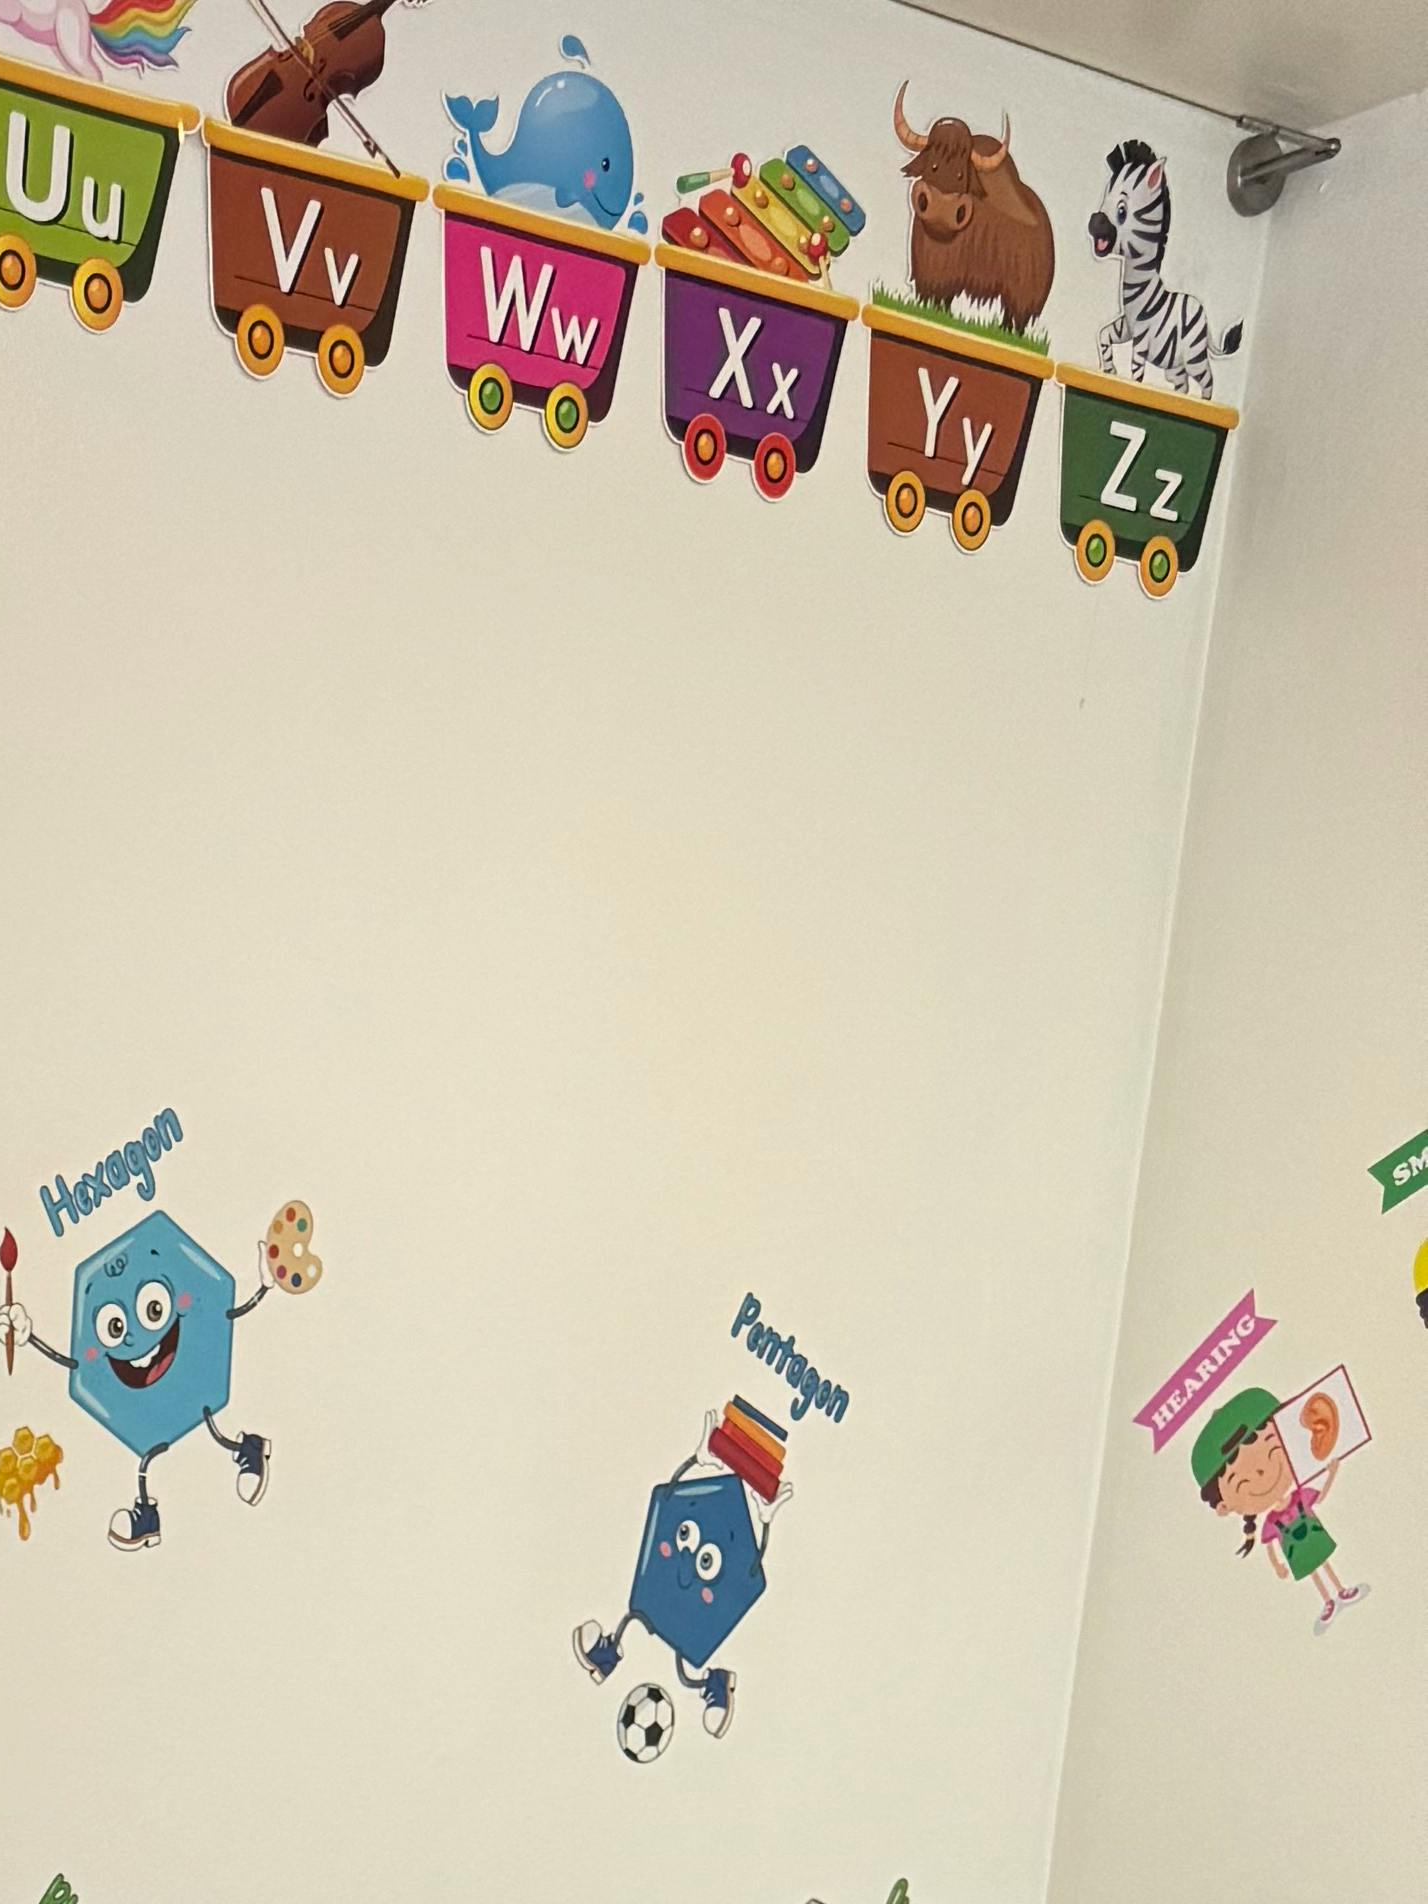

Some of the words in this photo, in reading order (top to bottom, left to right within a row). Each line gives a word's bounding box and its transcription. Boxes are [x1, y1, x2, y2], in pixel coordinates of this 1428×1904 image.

[5, 111, 123, 241] Uu
[260, 186, 359, 306] Vv
[479, 245, 599, 365] Ww
[708, 307, 799, 419] Xx
[917, 367, 993, 486] Yy
[1100, 421, 1184, 522] Zz
[40, 1107, 184, 1238] Hexagon
[730, 1292, 850, 1423] Pentagon
[1151, 1313, 1258, 1432] HEARING
